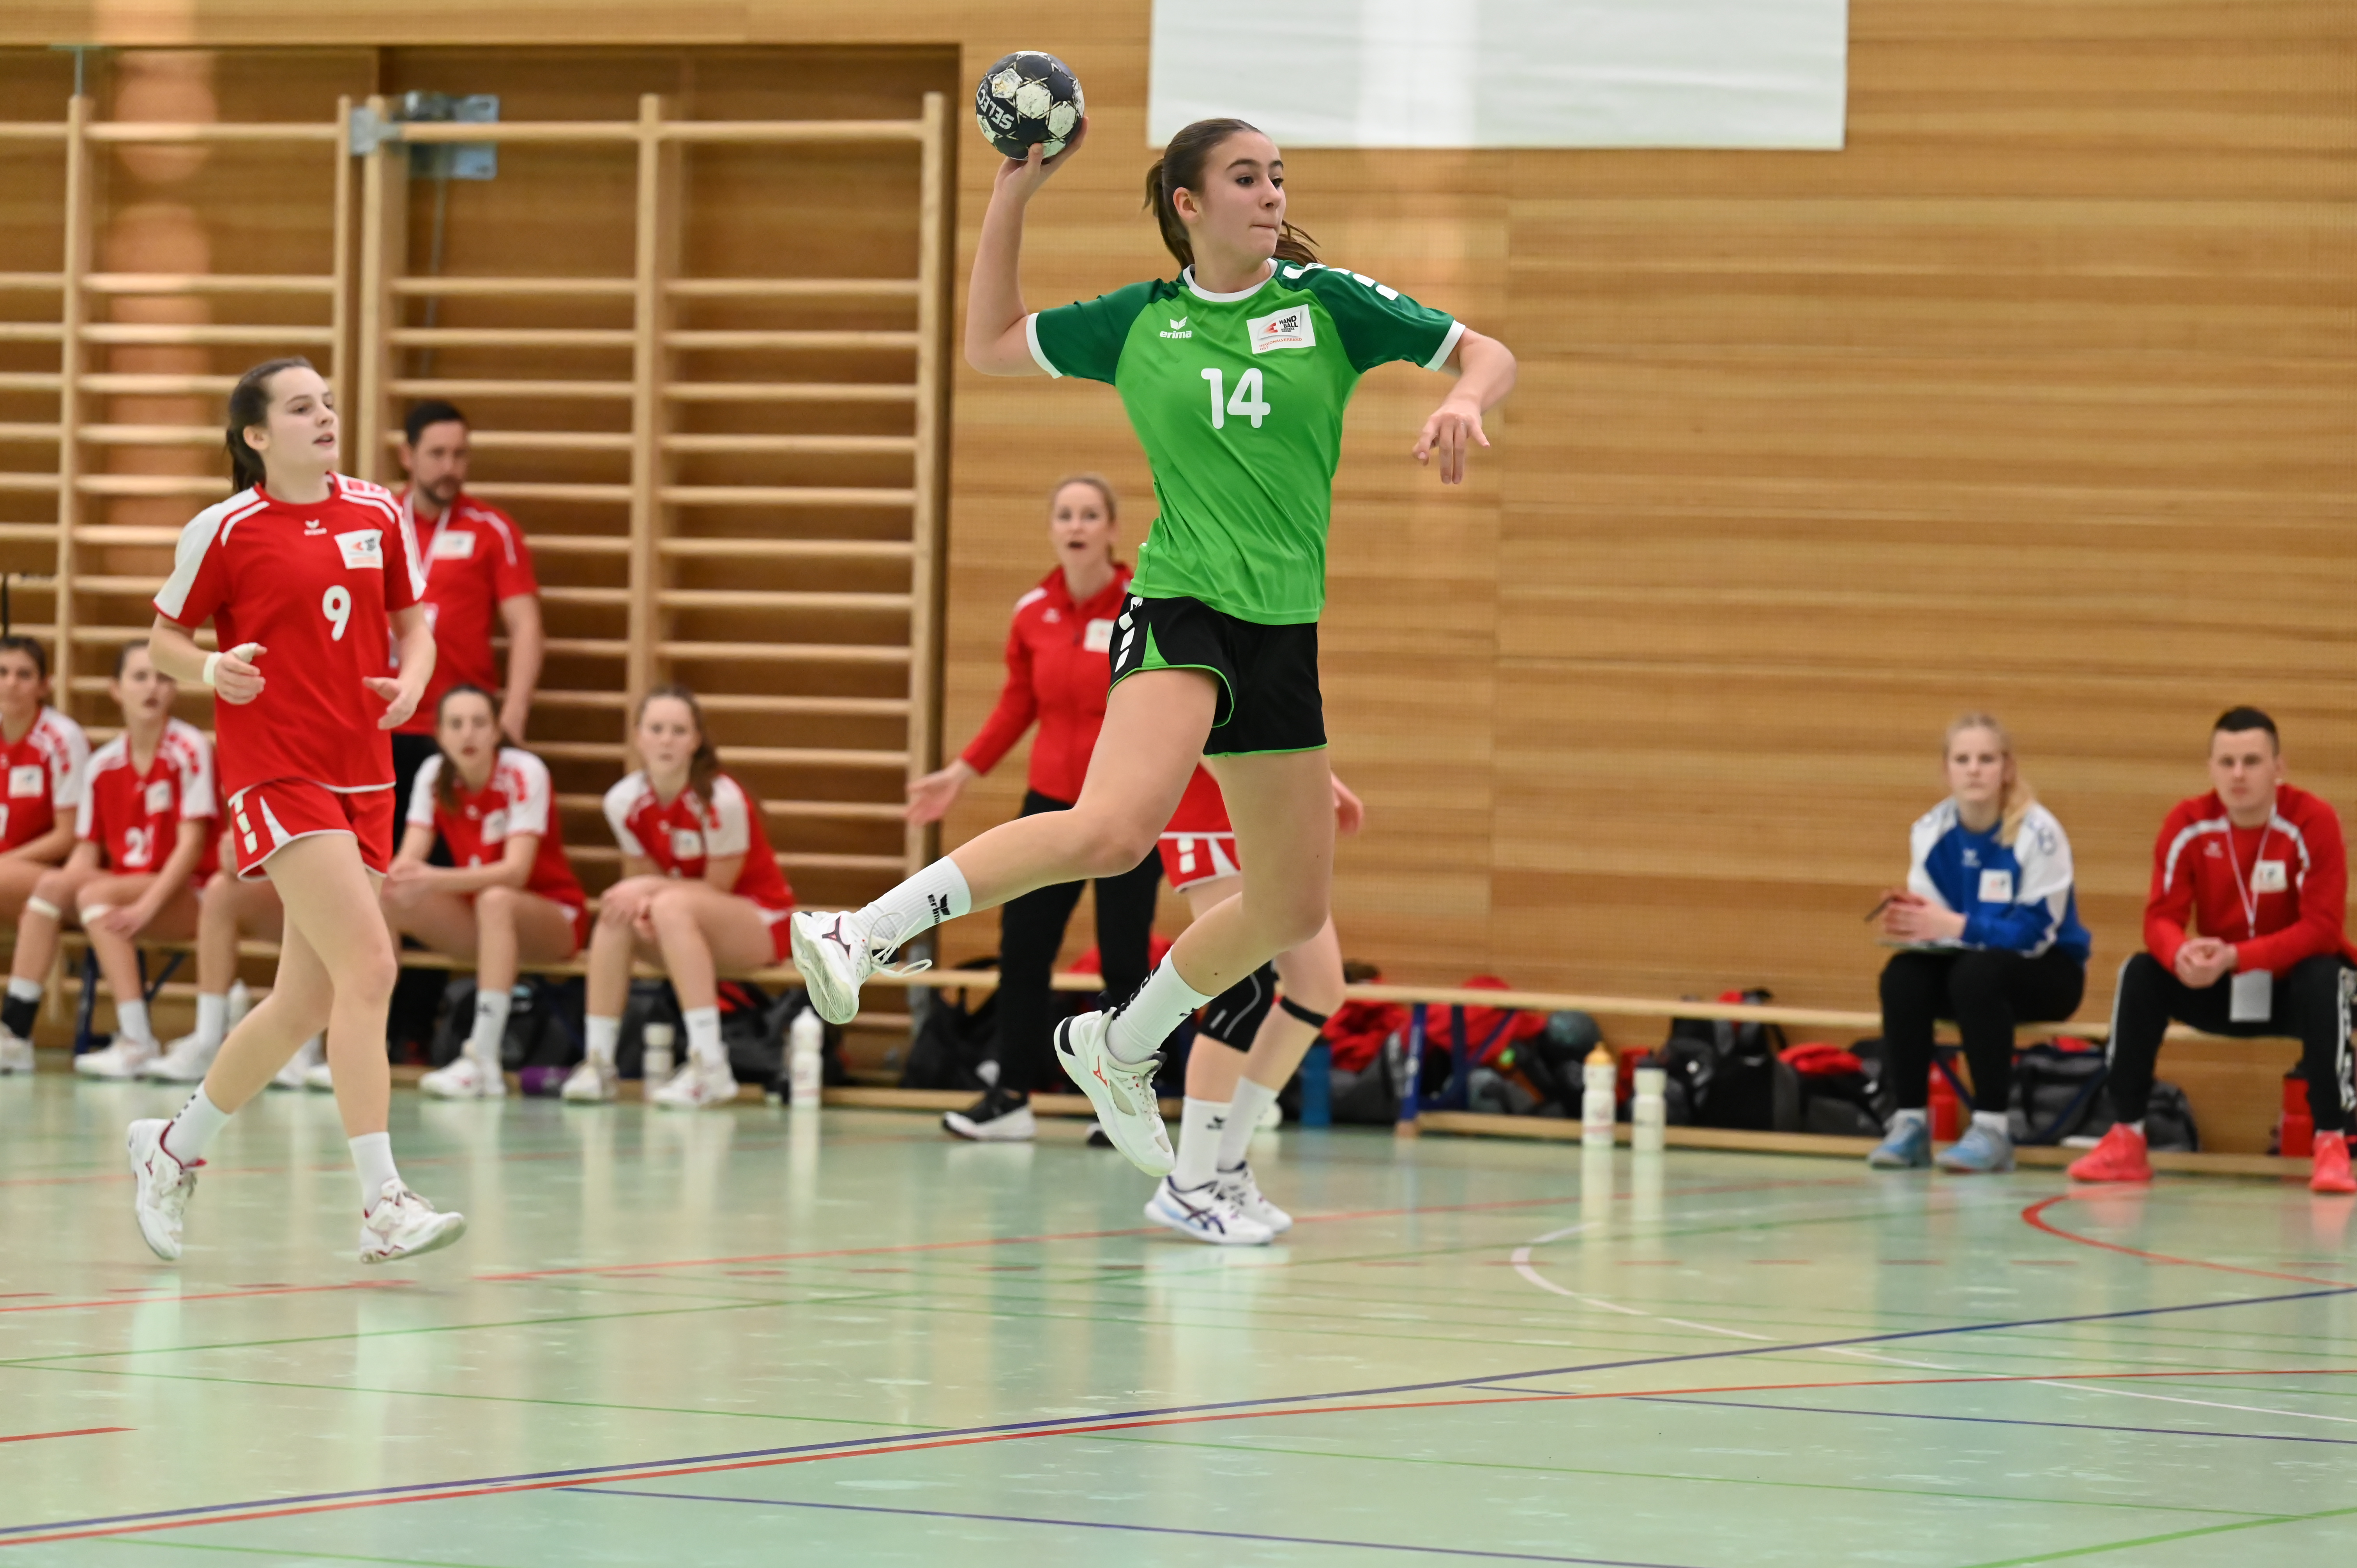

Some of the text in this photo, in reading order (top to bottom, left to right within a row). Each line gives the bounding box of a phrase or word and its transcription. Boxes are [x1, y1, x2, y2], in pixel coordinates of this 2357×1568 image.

[1279, 315, 1297, 325] HAND
[1159, 330, 1192, 339] erima
[1259, 338, 1302, 348] REGIONALVERBAND
[1201, 368, 1271, 429] 14
[322, 585, 351, 641] 9
[928, 894, 940, 924] erima
